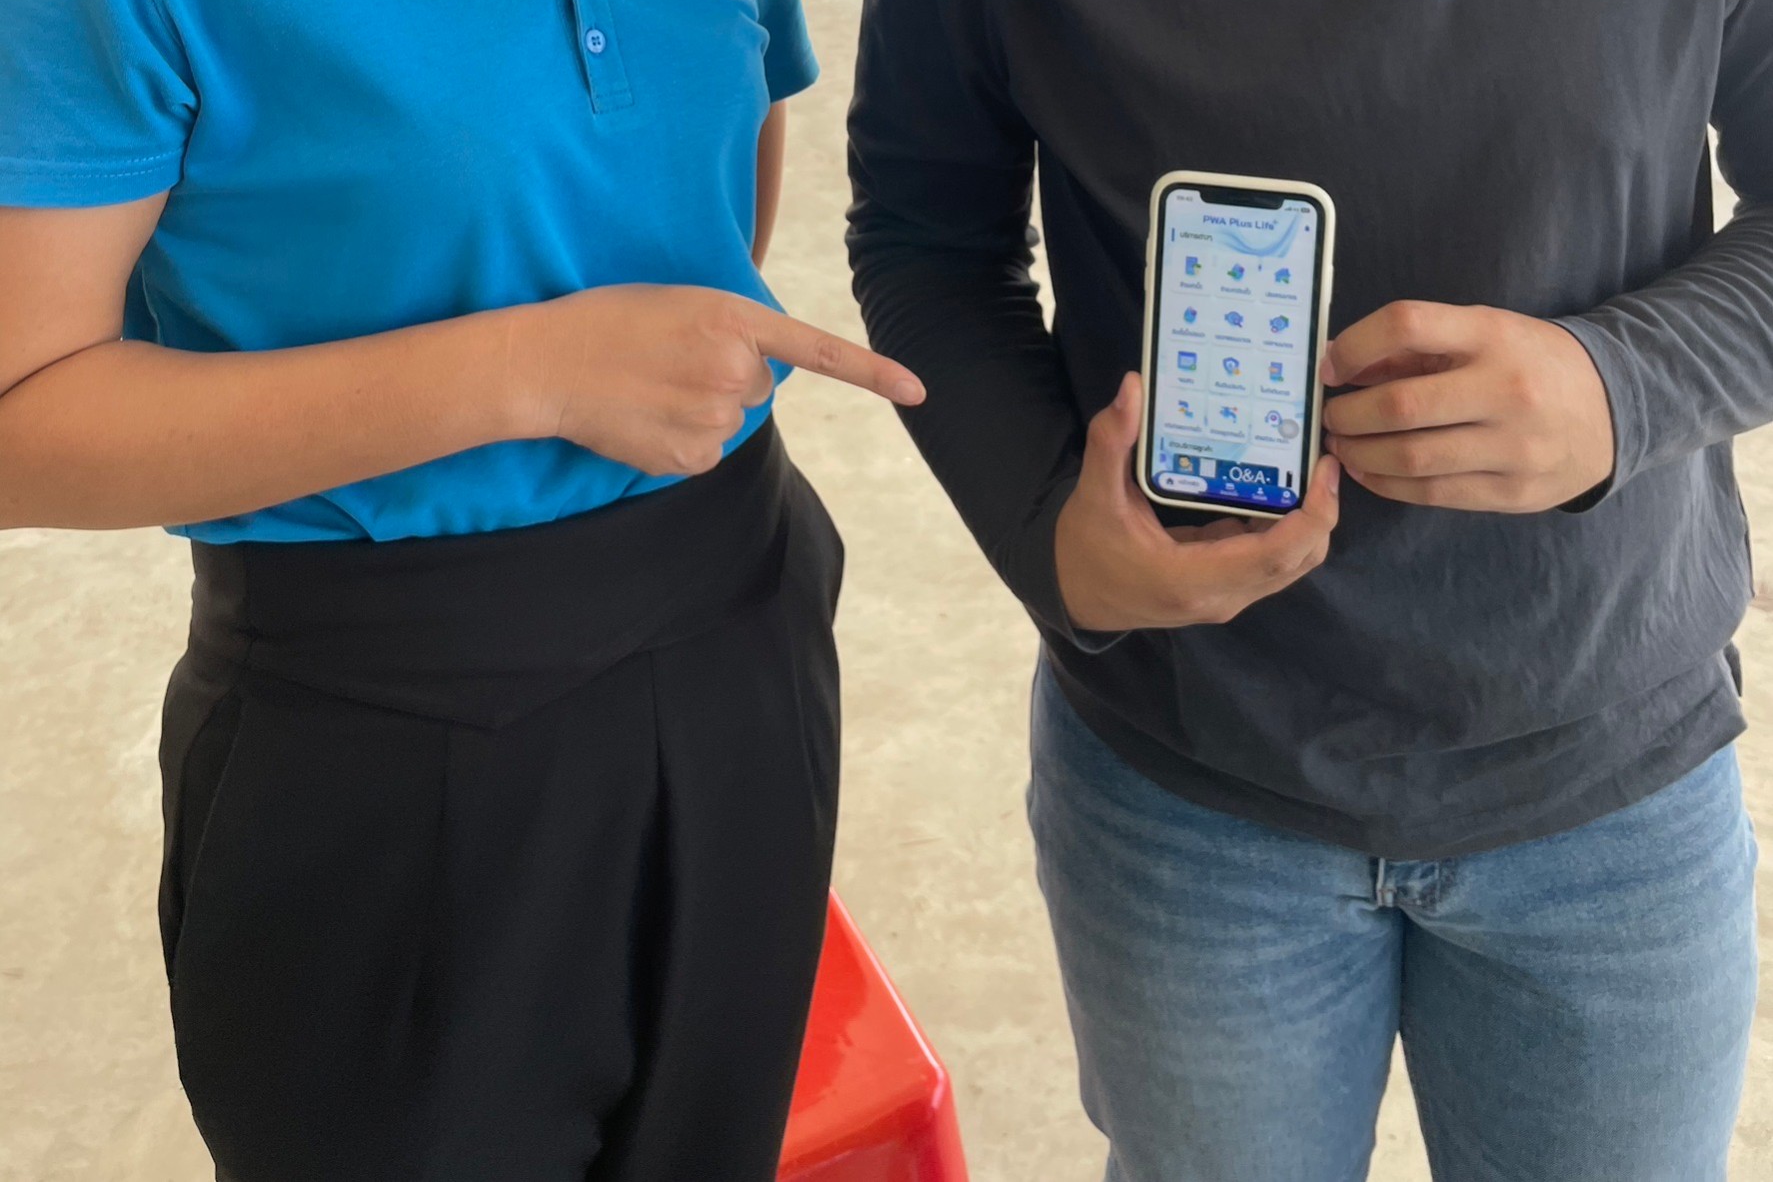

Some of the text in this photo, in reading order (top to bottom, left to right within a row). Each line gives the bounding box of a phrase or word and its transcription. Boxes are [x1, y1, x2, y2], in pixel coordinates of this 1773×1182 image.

[1203, 214, 1226, 226] PWA
[1229, 217, 1252, 229] Plus
[1229, 466, 1266, 485] Q&A
